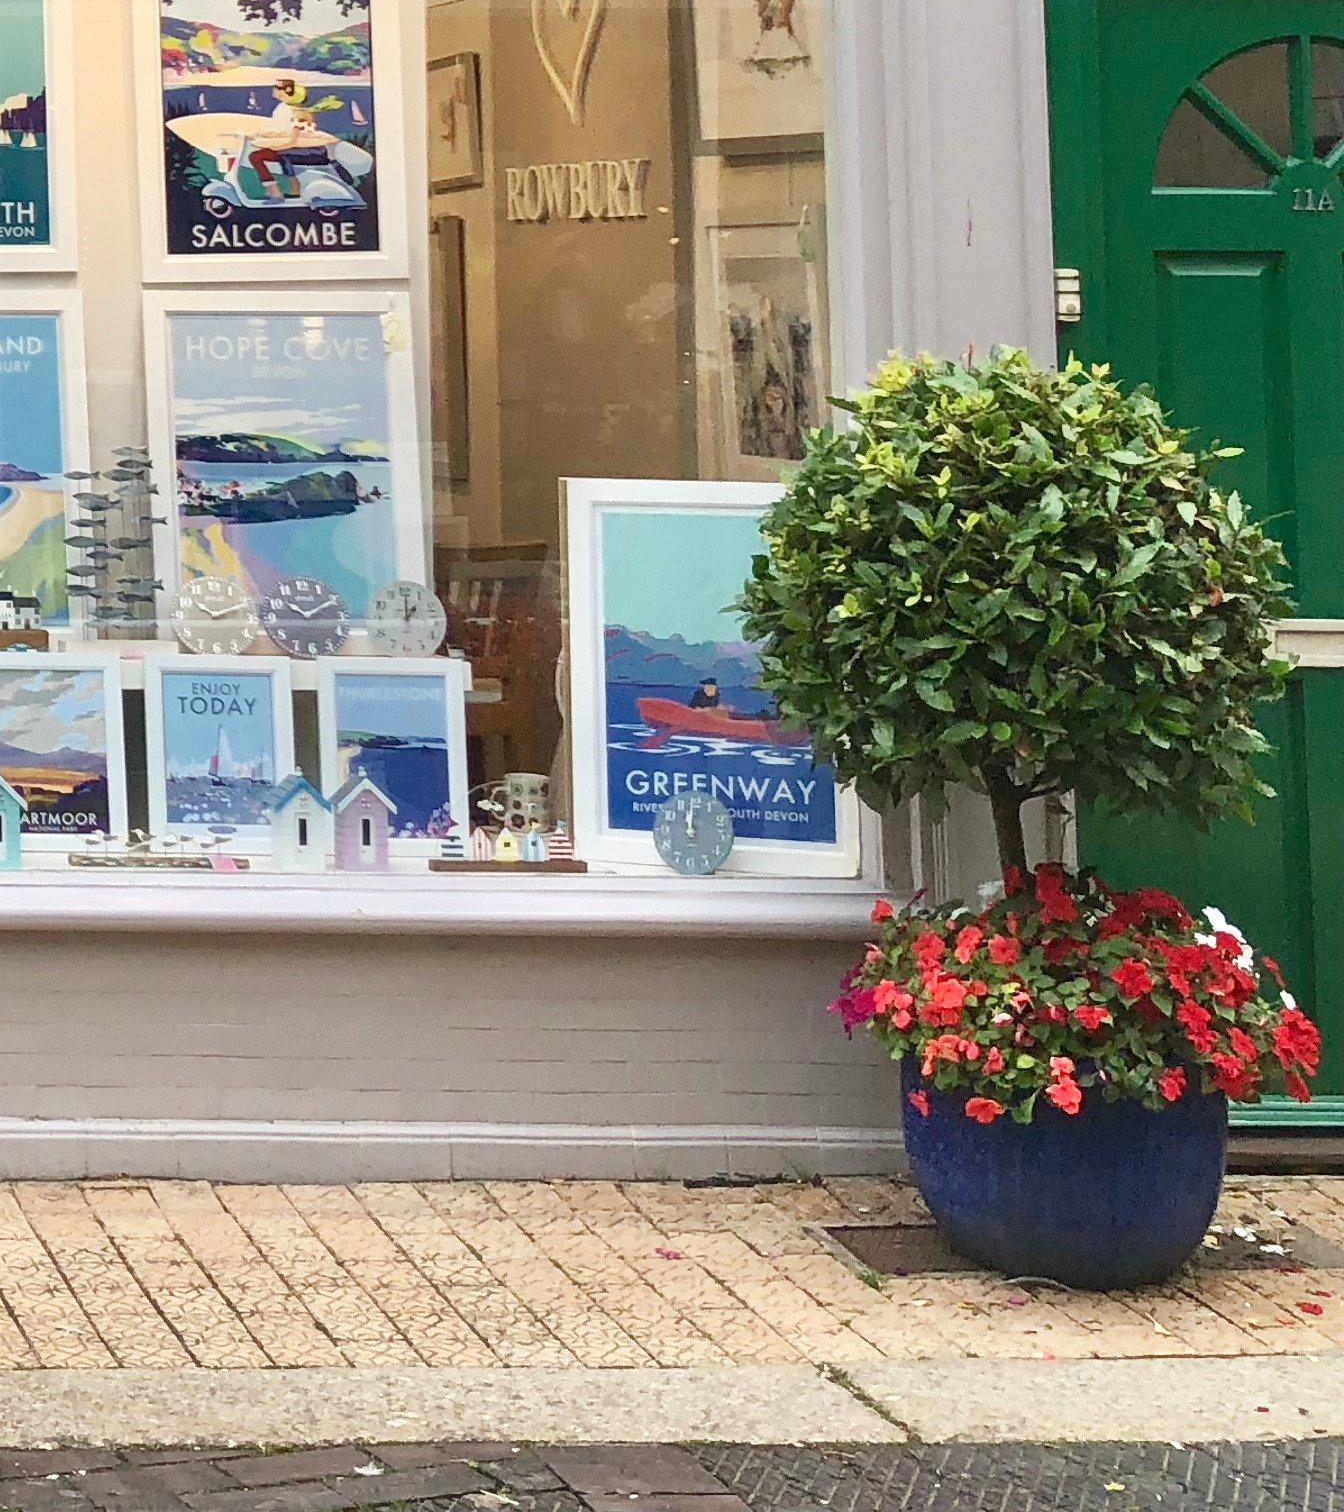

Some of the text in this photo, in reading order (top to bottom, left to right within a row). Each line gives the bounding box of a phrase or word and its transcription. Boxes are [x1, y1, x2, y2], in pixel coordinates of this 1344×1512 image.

[506, 158, 648, 221] ROWBURY
[1292, 188, 1335, 211] 11A
[191, 222, 356, 248] SALCOMBE
[186, 336, 370, 361] HOPE COVE
[192, 682, 241, 695] ENJOY
[177, 695, 257, 716] TODAY
[625, 769, 817, 805] GREENWAY
[20, 811, 97, 826] ARTMOOR
[727, 807, 760, 820] OUTH
[764, 810, 809, 823] DEVON
